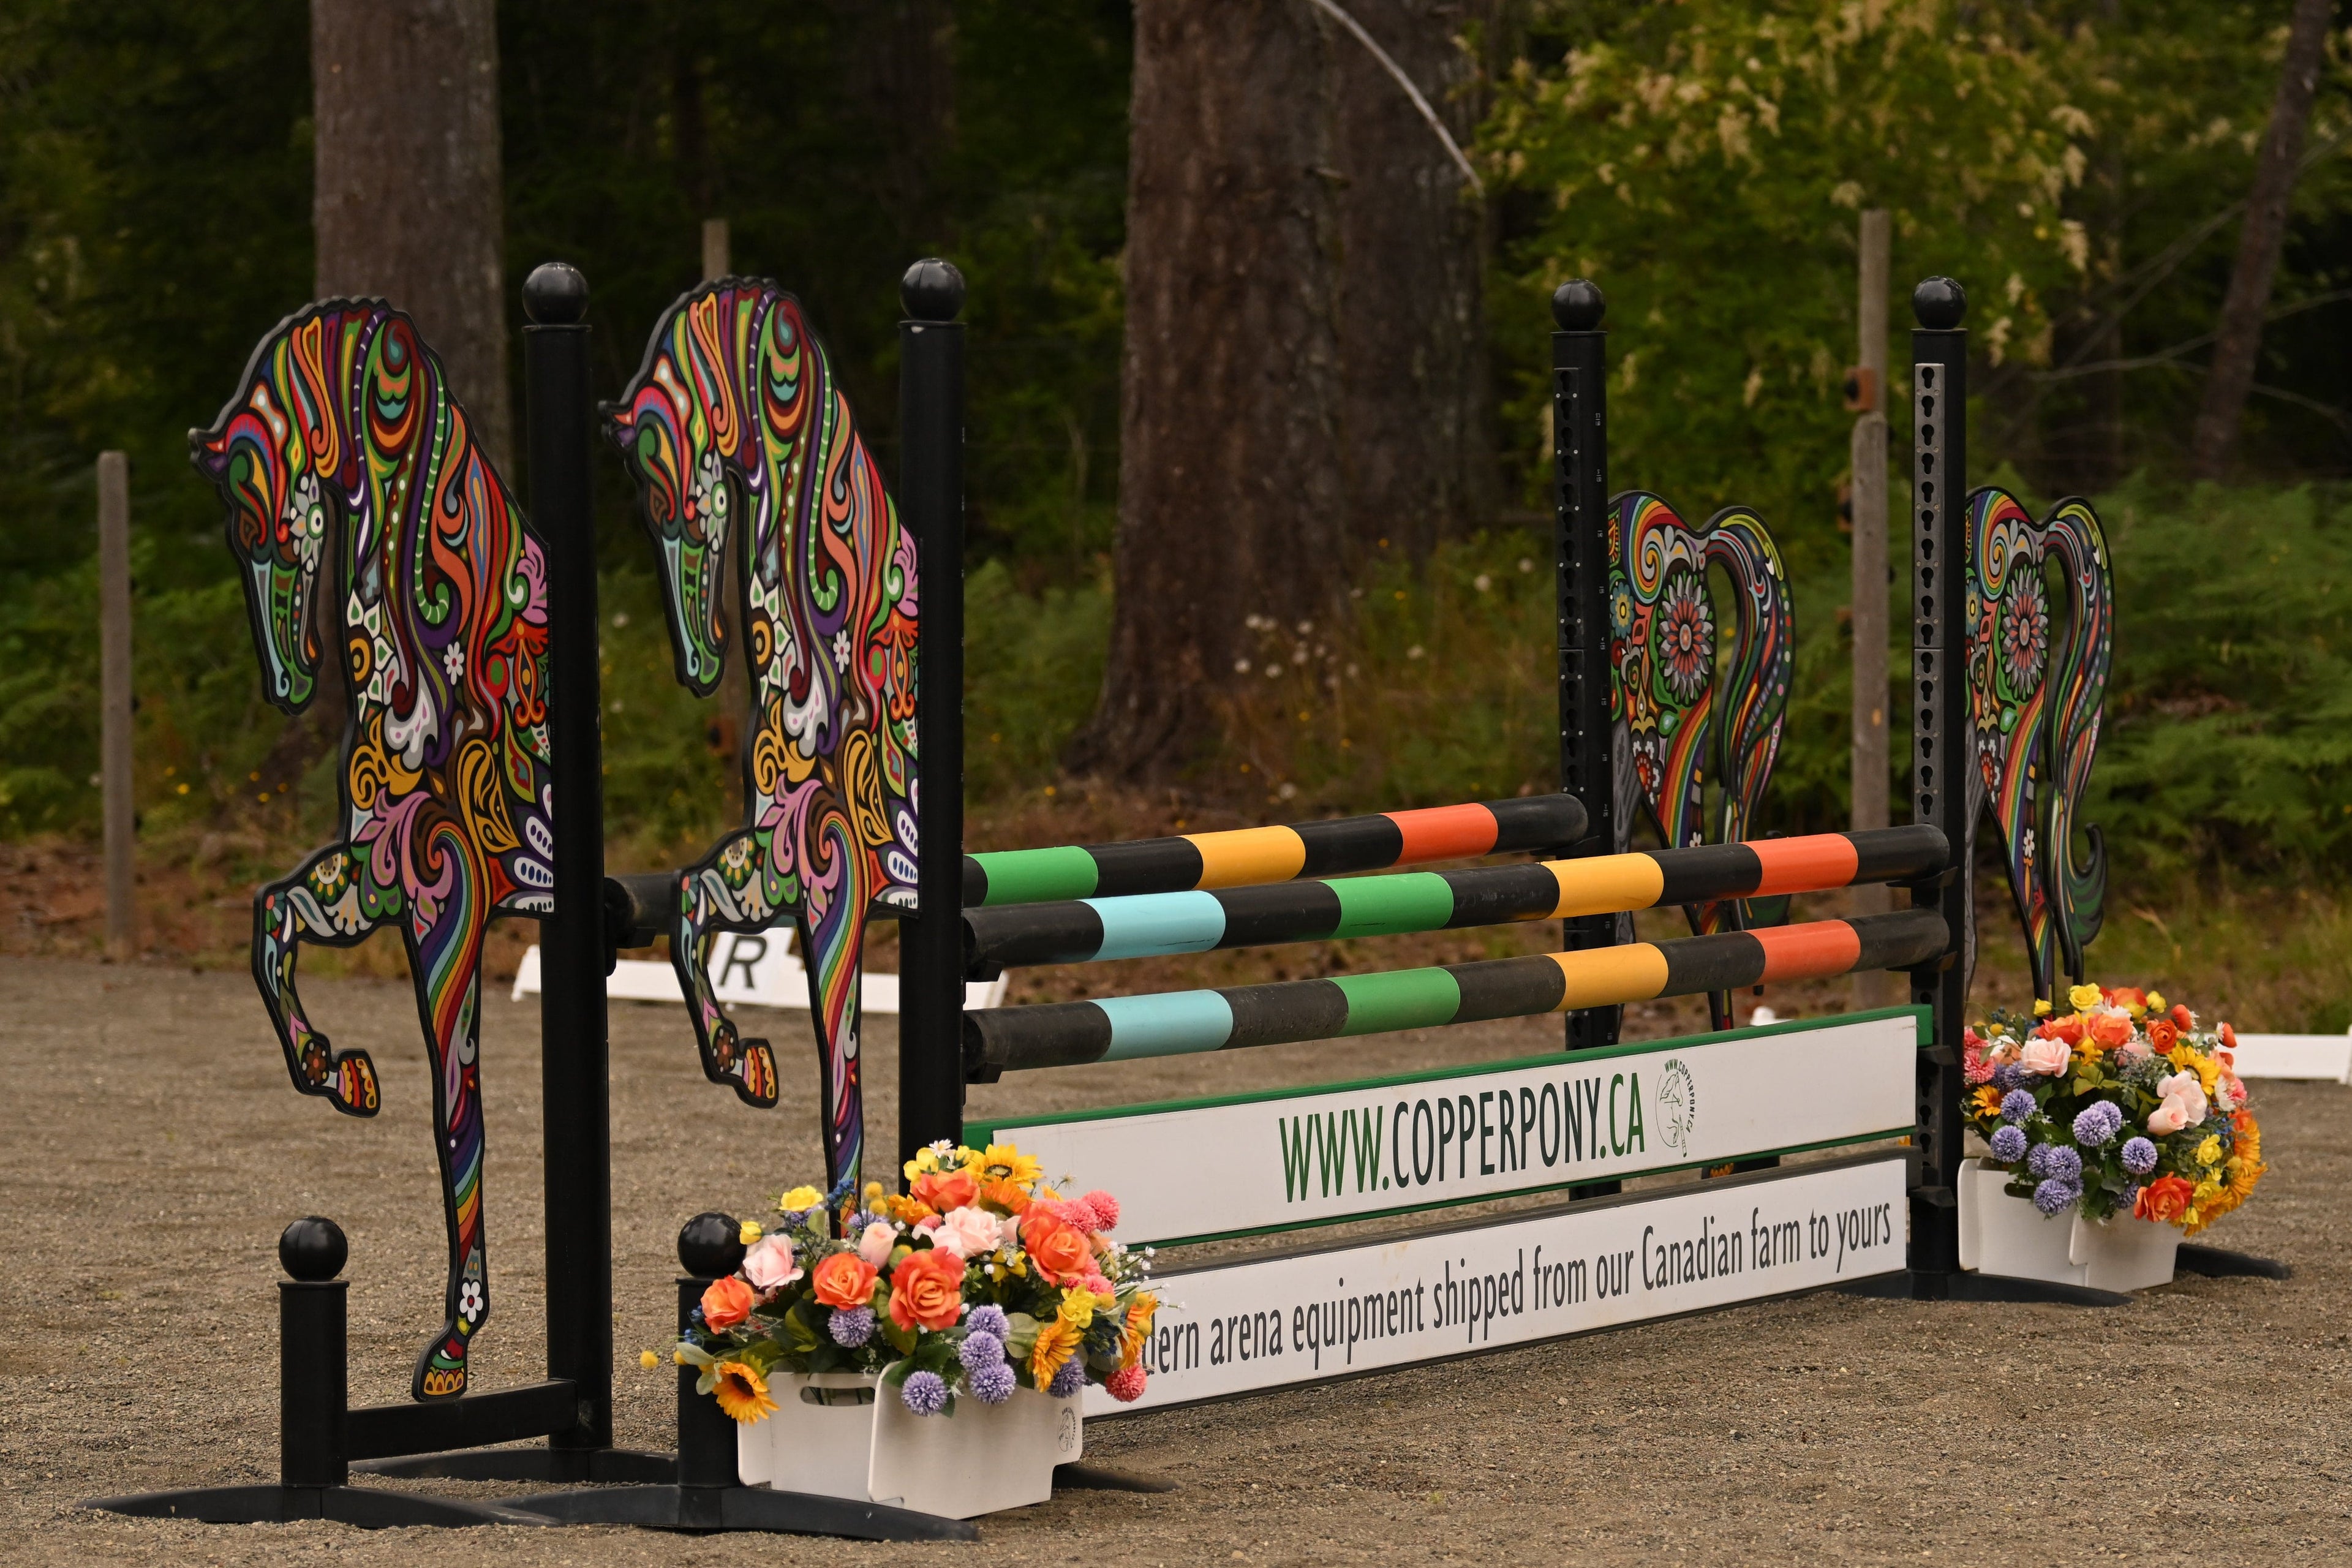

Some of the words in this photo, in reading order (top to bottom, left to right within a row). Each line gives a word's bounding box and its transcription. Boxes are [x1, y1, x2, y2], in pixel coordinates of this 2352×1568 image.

[720, 935, 767, 989] R
[1279, 1072, 1645, 1203] WWW.COPPERPONY.CA
[1664, 1058, 1695, 1133] WWW.COPPERPONY.CA
[1142, 1312, 1199, 1376] dern
[1210, 1309, 1283, 1366] arena
[1293, 1277, 1424, 1370] equipment
[1433, 1248, 1523, 1343] shipped
[1533, 1245, 1586, 1310] from
[1596, 1250, 1634, 1299] our
[1642, 1215, 1743, 1291] Canadian
[1751, 1207, 1800, 1270] farm
[1809, 1208, 1829, 1259] to
[1836, 1203, 1891, 1273] yours
